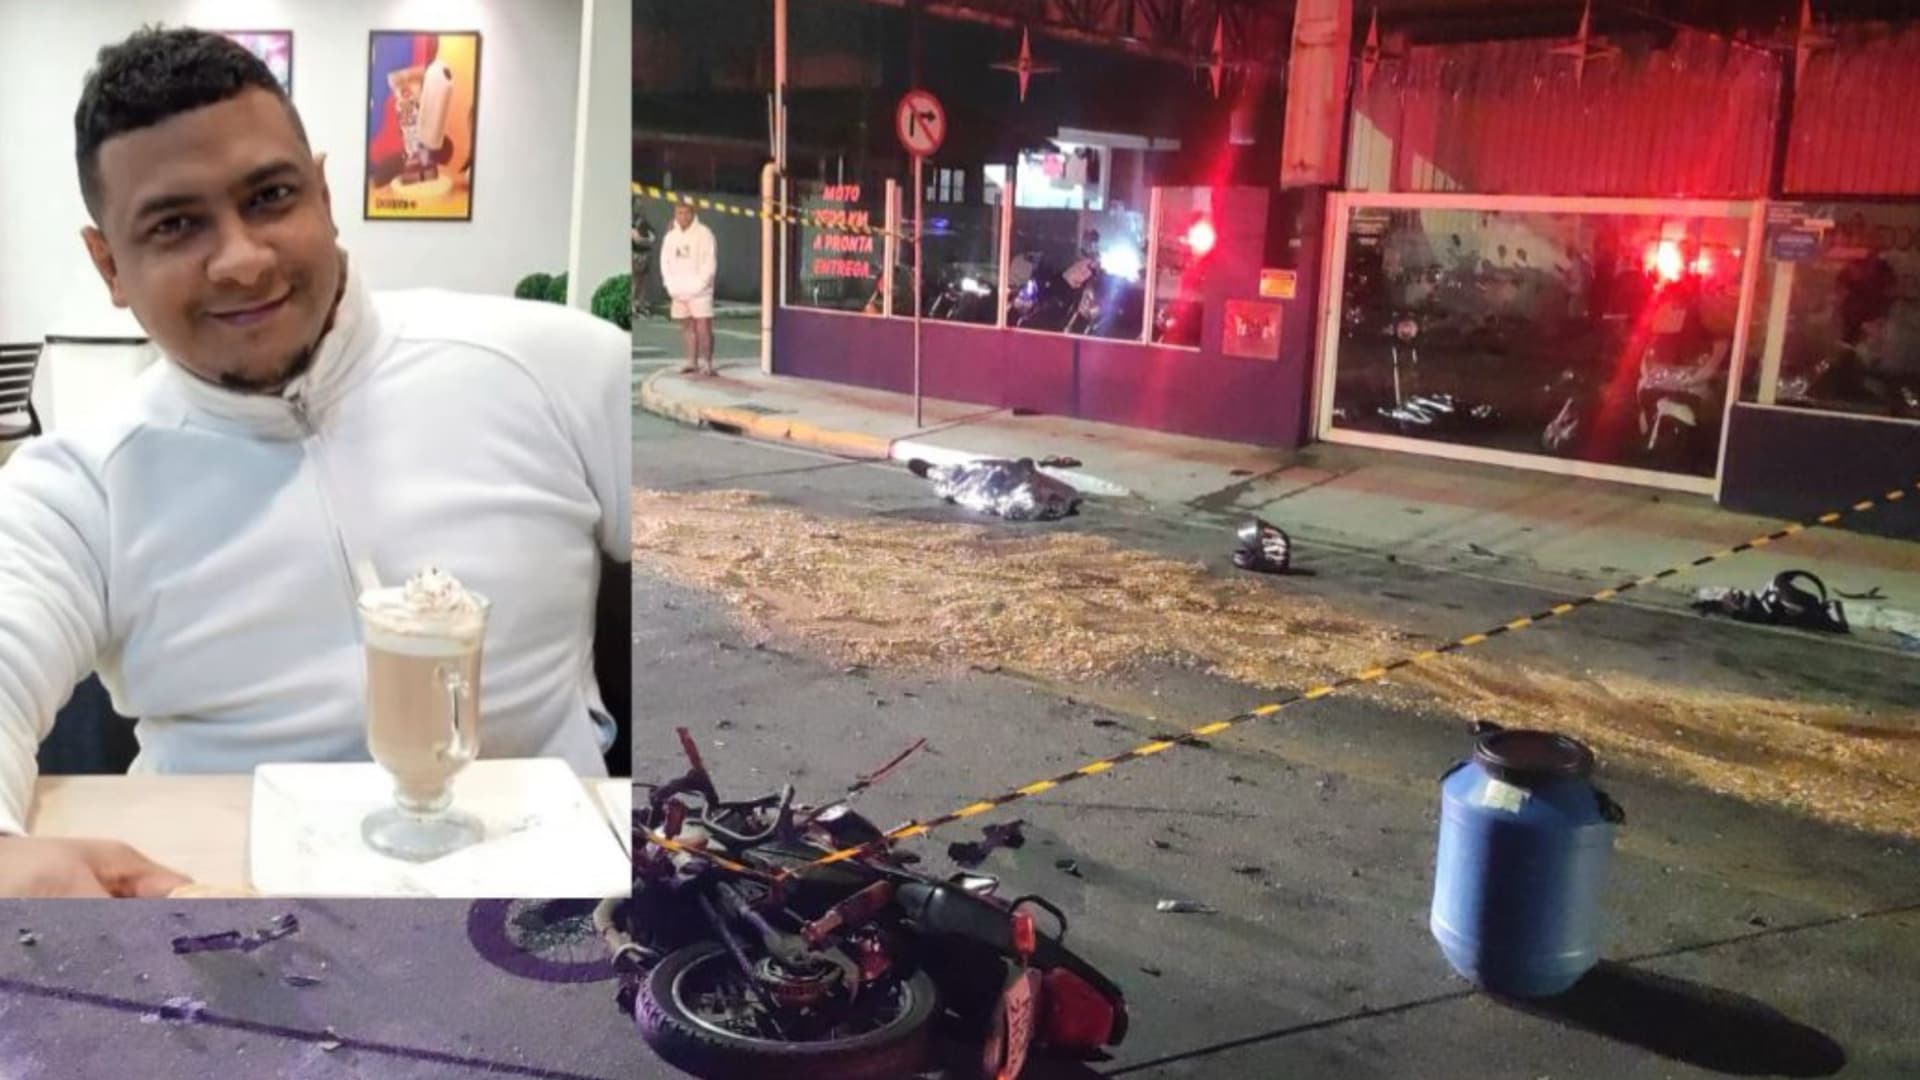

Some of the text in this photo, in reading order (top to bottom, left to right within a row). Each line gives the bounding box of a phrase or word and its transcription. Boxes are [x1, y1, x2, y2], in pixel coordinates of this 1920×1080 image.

[822, 184, 860, 203] MOTO
[812, 234, 873, 253] A PRONTA
[812, 258, 870, 279] ENTREGA
